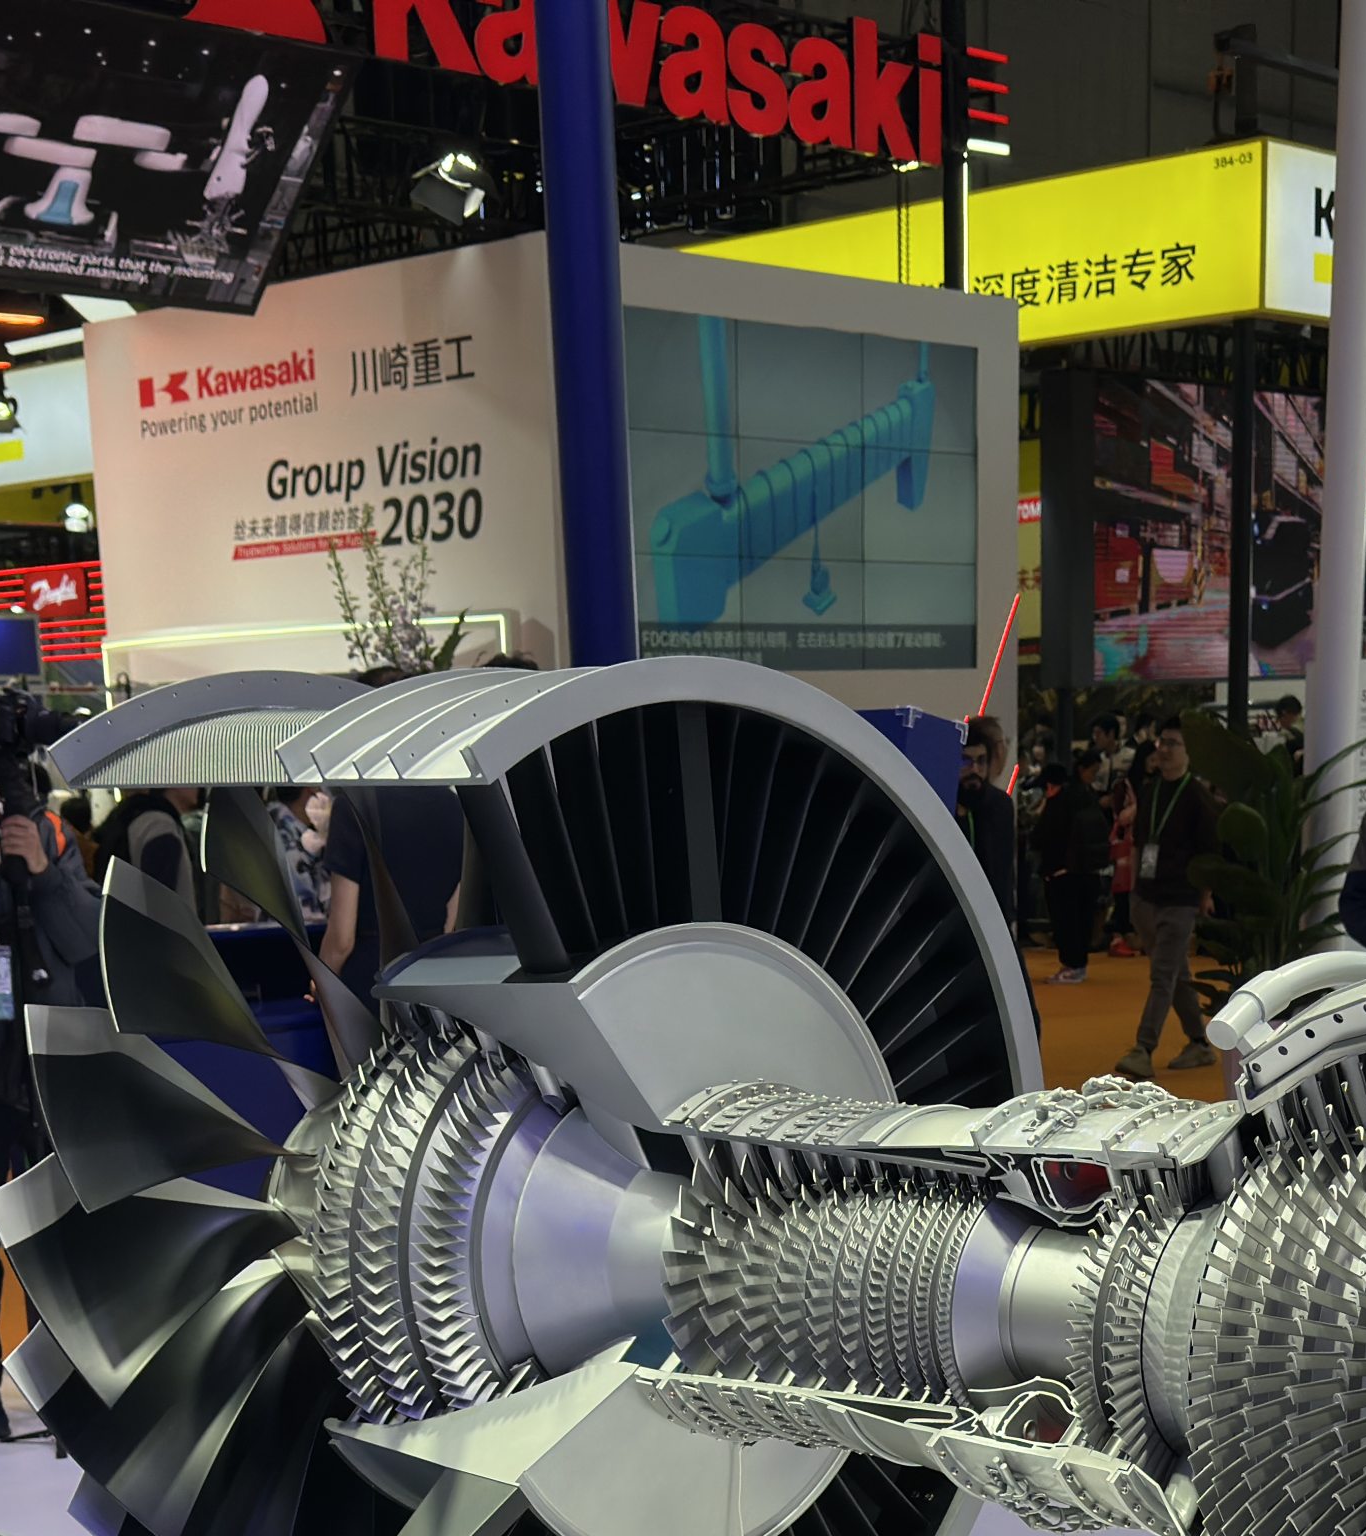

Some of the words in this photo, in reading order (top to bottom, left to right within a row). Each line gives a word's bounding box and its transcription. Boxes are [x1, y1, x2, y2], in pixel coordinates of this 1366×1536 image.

[78, 252, 117, 271] parts
[148, 259, 172, 274] the
[196, 348, 316, 400] Kawasaki
[350, 334, 476, 398] 川崎重工
[140, 411, 208, 440] Powering
[211, 405, 244, 431] your
[248, 391, 319, 424] potential
[266, 457, 366, 503] Group
[376, 436, 482, 488] Vision
[380, 488, 484, 547] 2030
